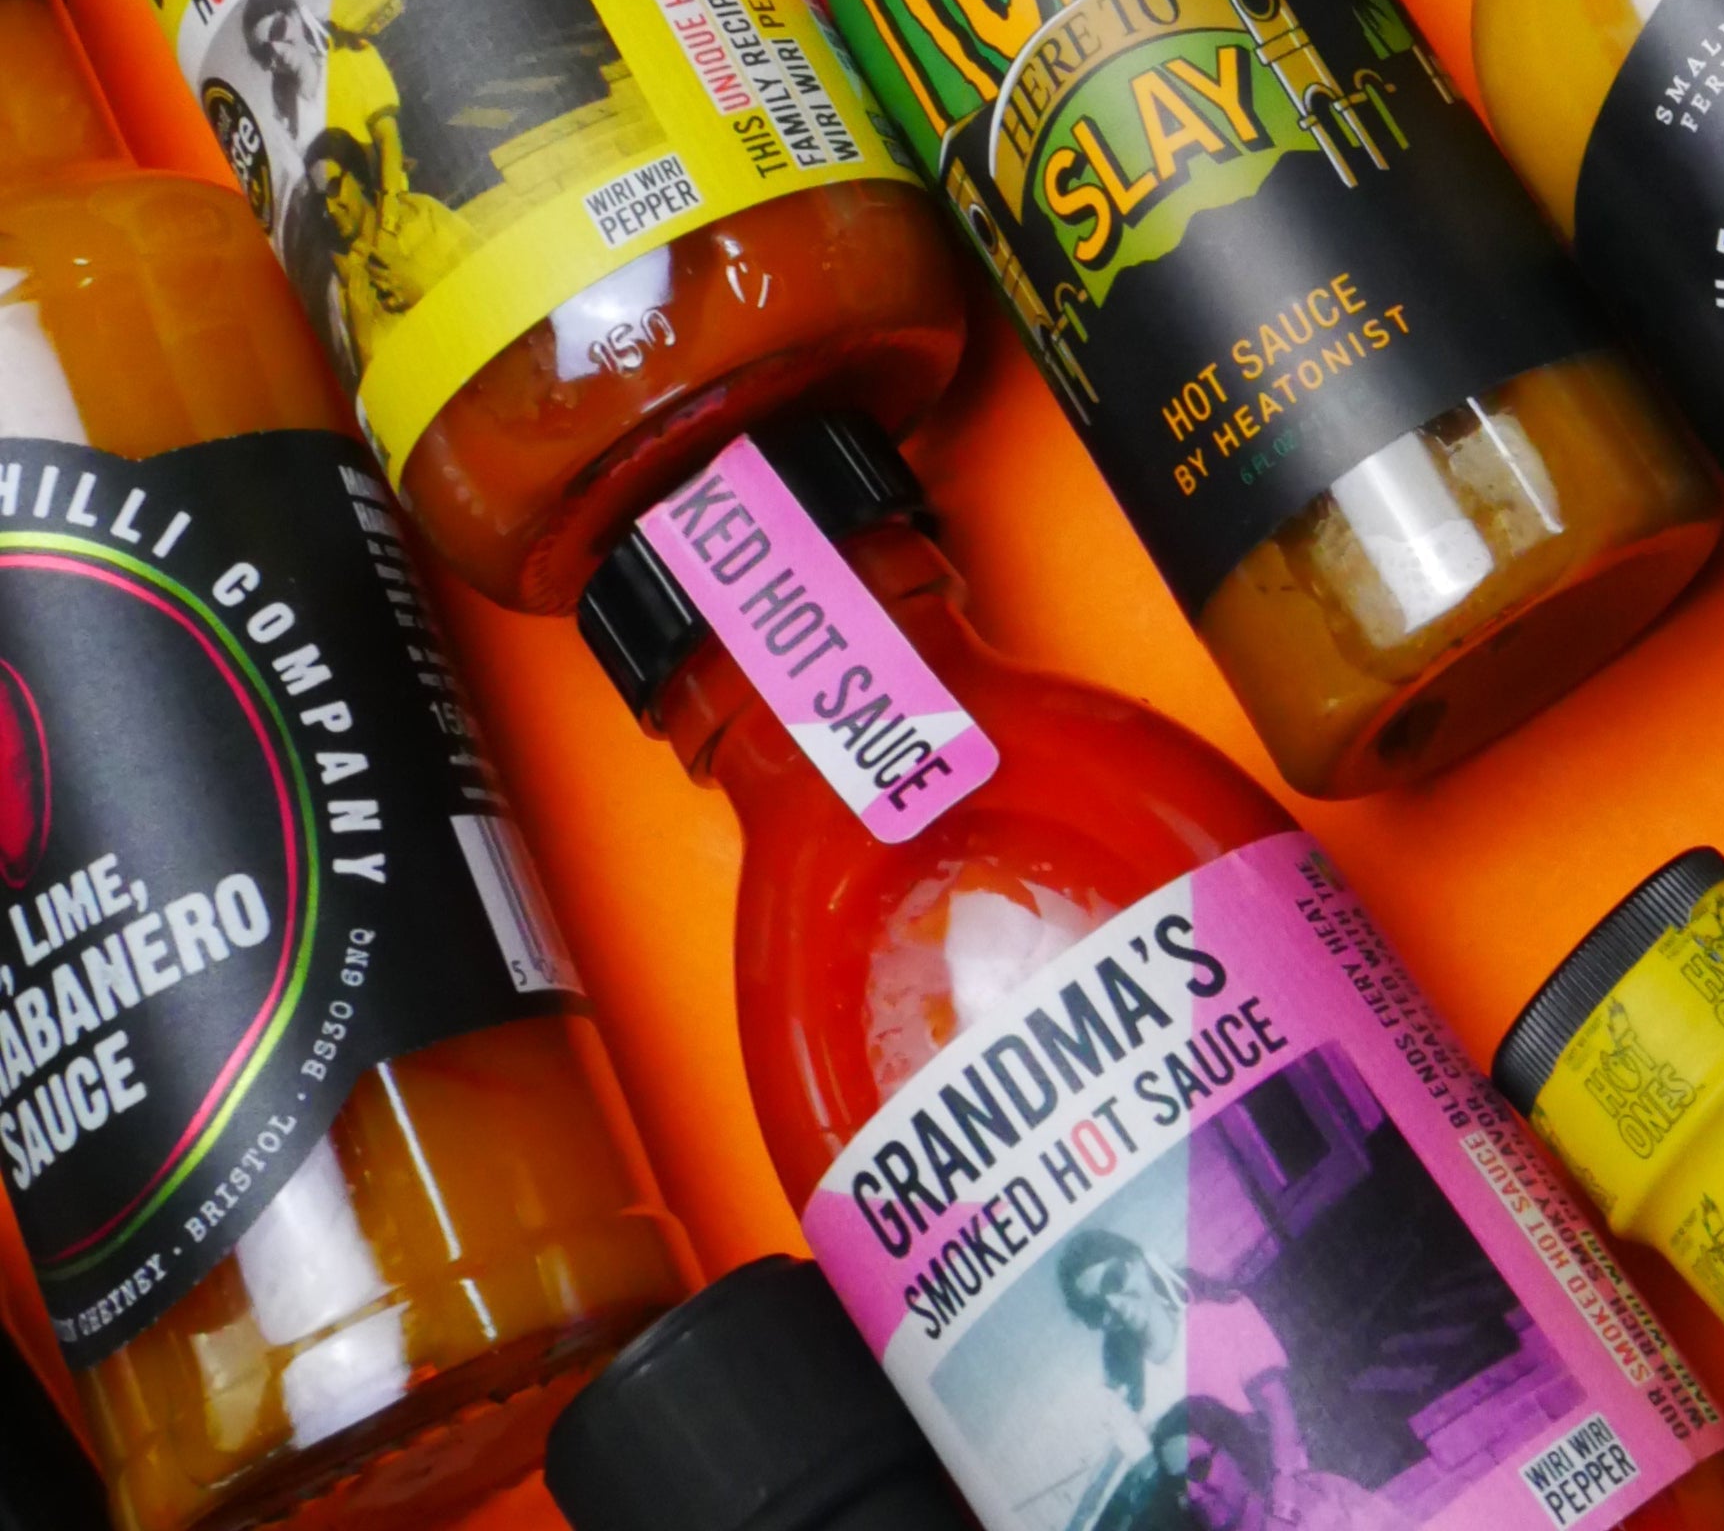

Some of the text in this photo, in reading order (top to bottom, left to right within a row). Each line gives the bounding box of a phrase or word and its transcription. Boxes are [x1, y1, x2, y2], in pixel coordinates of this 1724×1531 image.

[674, 11, 753, 113] UNIQUE
[756, 76, 820, 168] FAMILY
[999, 15, 1103, 159] HERE
[587, 171, 638, 217] WIRI
[601, 179, 700, 246] PEPPER
[733, 114, 787, 179] THIS
[1043, 43, 1272, 269] SLAY
[1162, 272, 1367, 441] HOT SAUCE
[1173, 303, 1411, 496] BY HEATONIST
[211, 561, 388, 885] COMPANY
[739, 568, 953, 811] HOT SAUCE
[0, 1030, 148, 1191] SAUCE
[184, 1001, 355, 1244] BRISTOL BS30
[852, 914, 1227, 1259] GRANDMA'S
[904, 996, 1288, 1340] SMOKED HOT SAUCE
[1543, 1445, 1637, 1527] PEPPER
